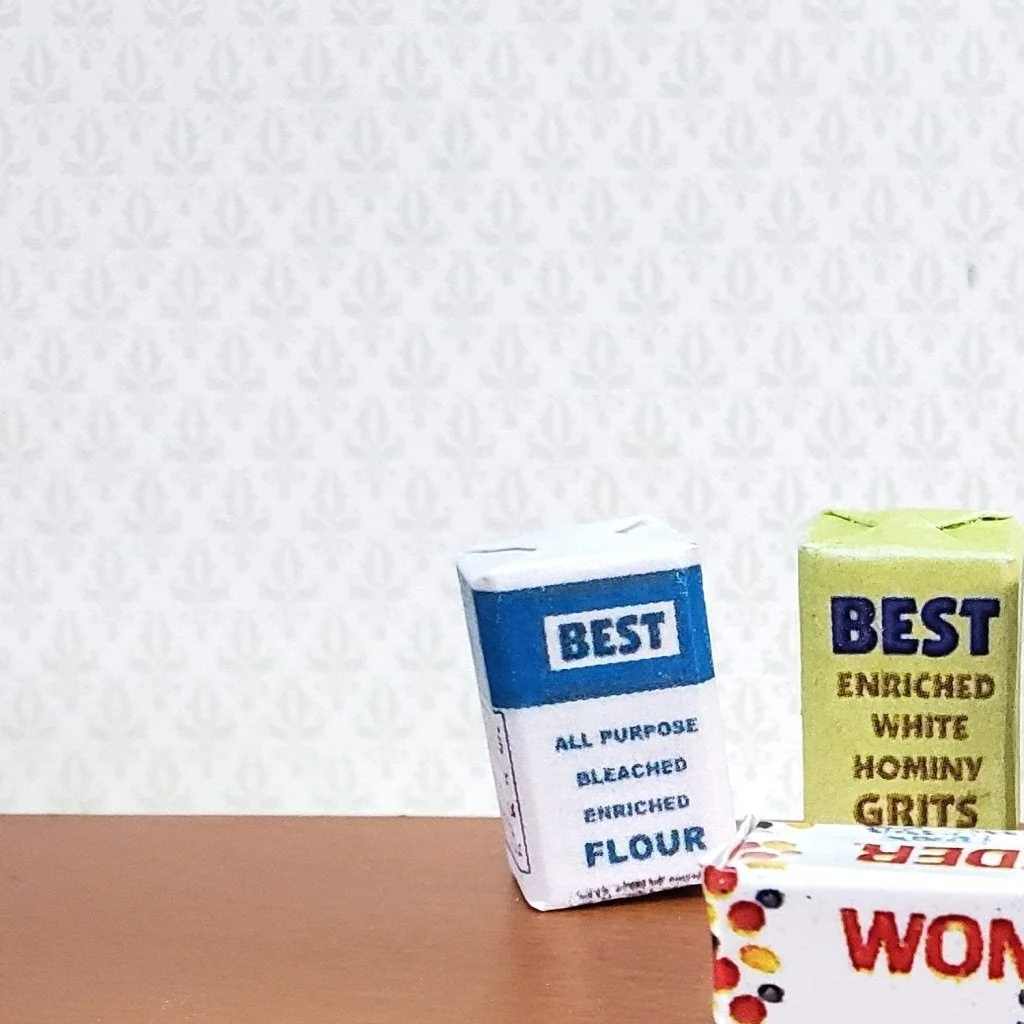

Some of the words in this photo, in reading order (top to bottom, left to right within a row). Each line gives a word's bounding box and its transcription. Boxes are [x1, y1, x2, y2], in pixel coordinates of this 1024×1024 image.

[558, 610, 665, 662] BEST
[831, 596, 1000, 657] BEST
[837, 671, 995, 699] ENRICHED
[555, 733, 593, 752] ALL
[600, 717, 699, 745] PURPOSE
[871, 713, 969, 740] WHITE
[577, 757, 687, 788] BLEACHED
[853, 755, 983, 781] HOMINY
[583, 794, 690, 823] ENRICHED
[852, 793, 978, 828] GRITS
[584, 826, 707, 868] FLOUR
